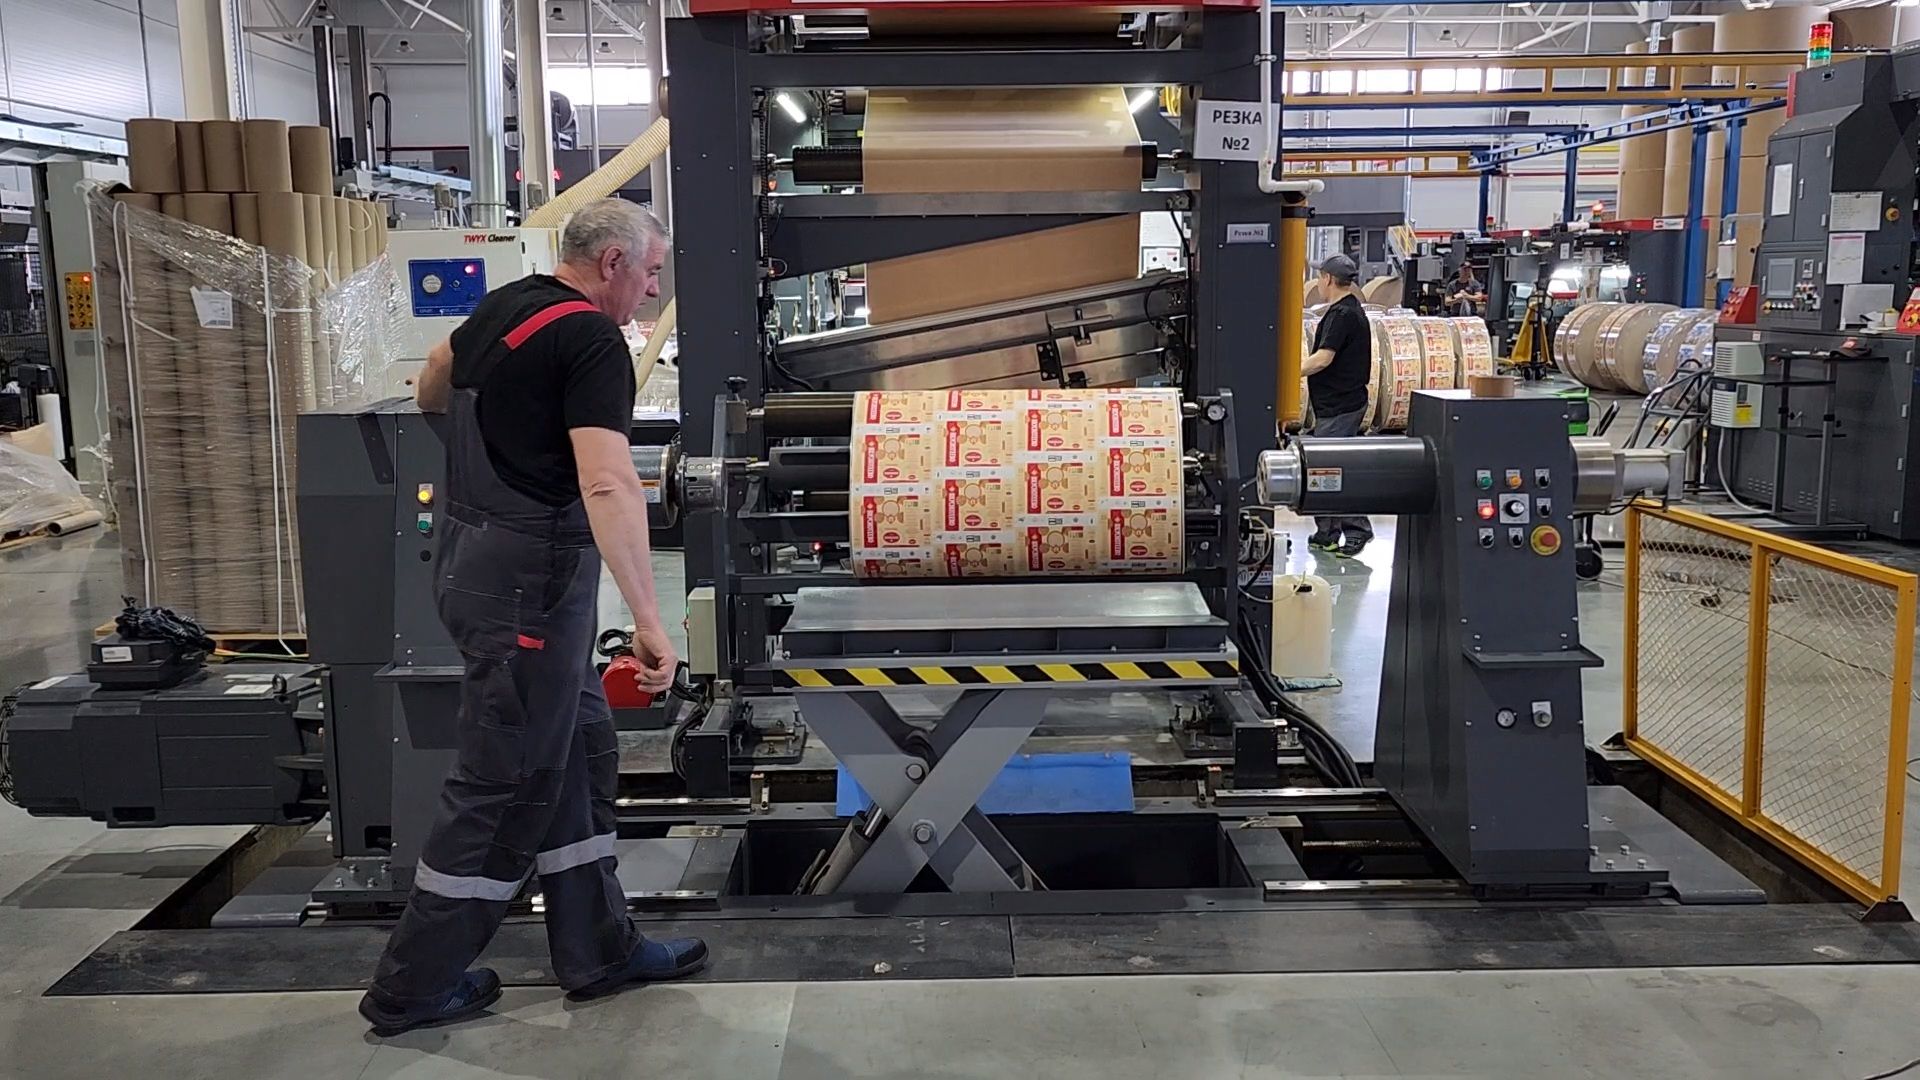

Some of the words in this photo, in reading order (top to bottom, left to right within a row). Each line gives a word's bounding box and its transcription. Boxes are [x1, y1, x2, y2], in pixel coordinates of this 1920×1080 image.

[1213, 109, 1262, 125] РЕЗКА
[1222, 136, 1250, 151] №2
[464, 234, 487, 243] TWYX
[488, 234, 516, 242] Cleaner
